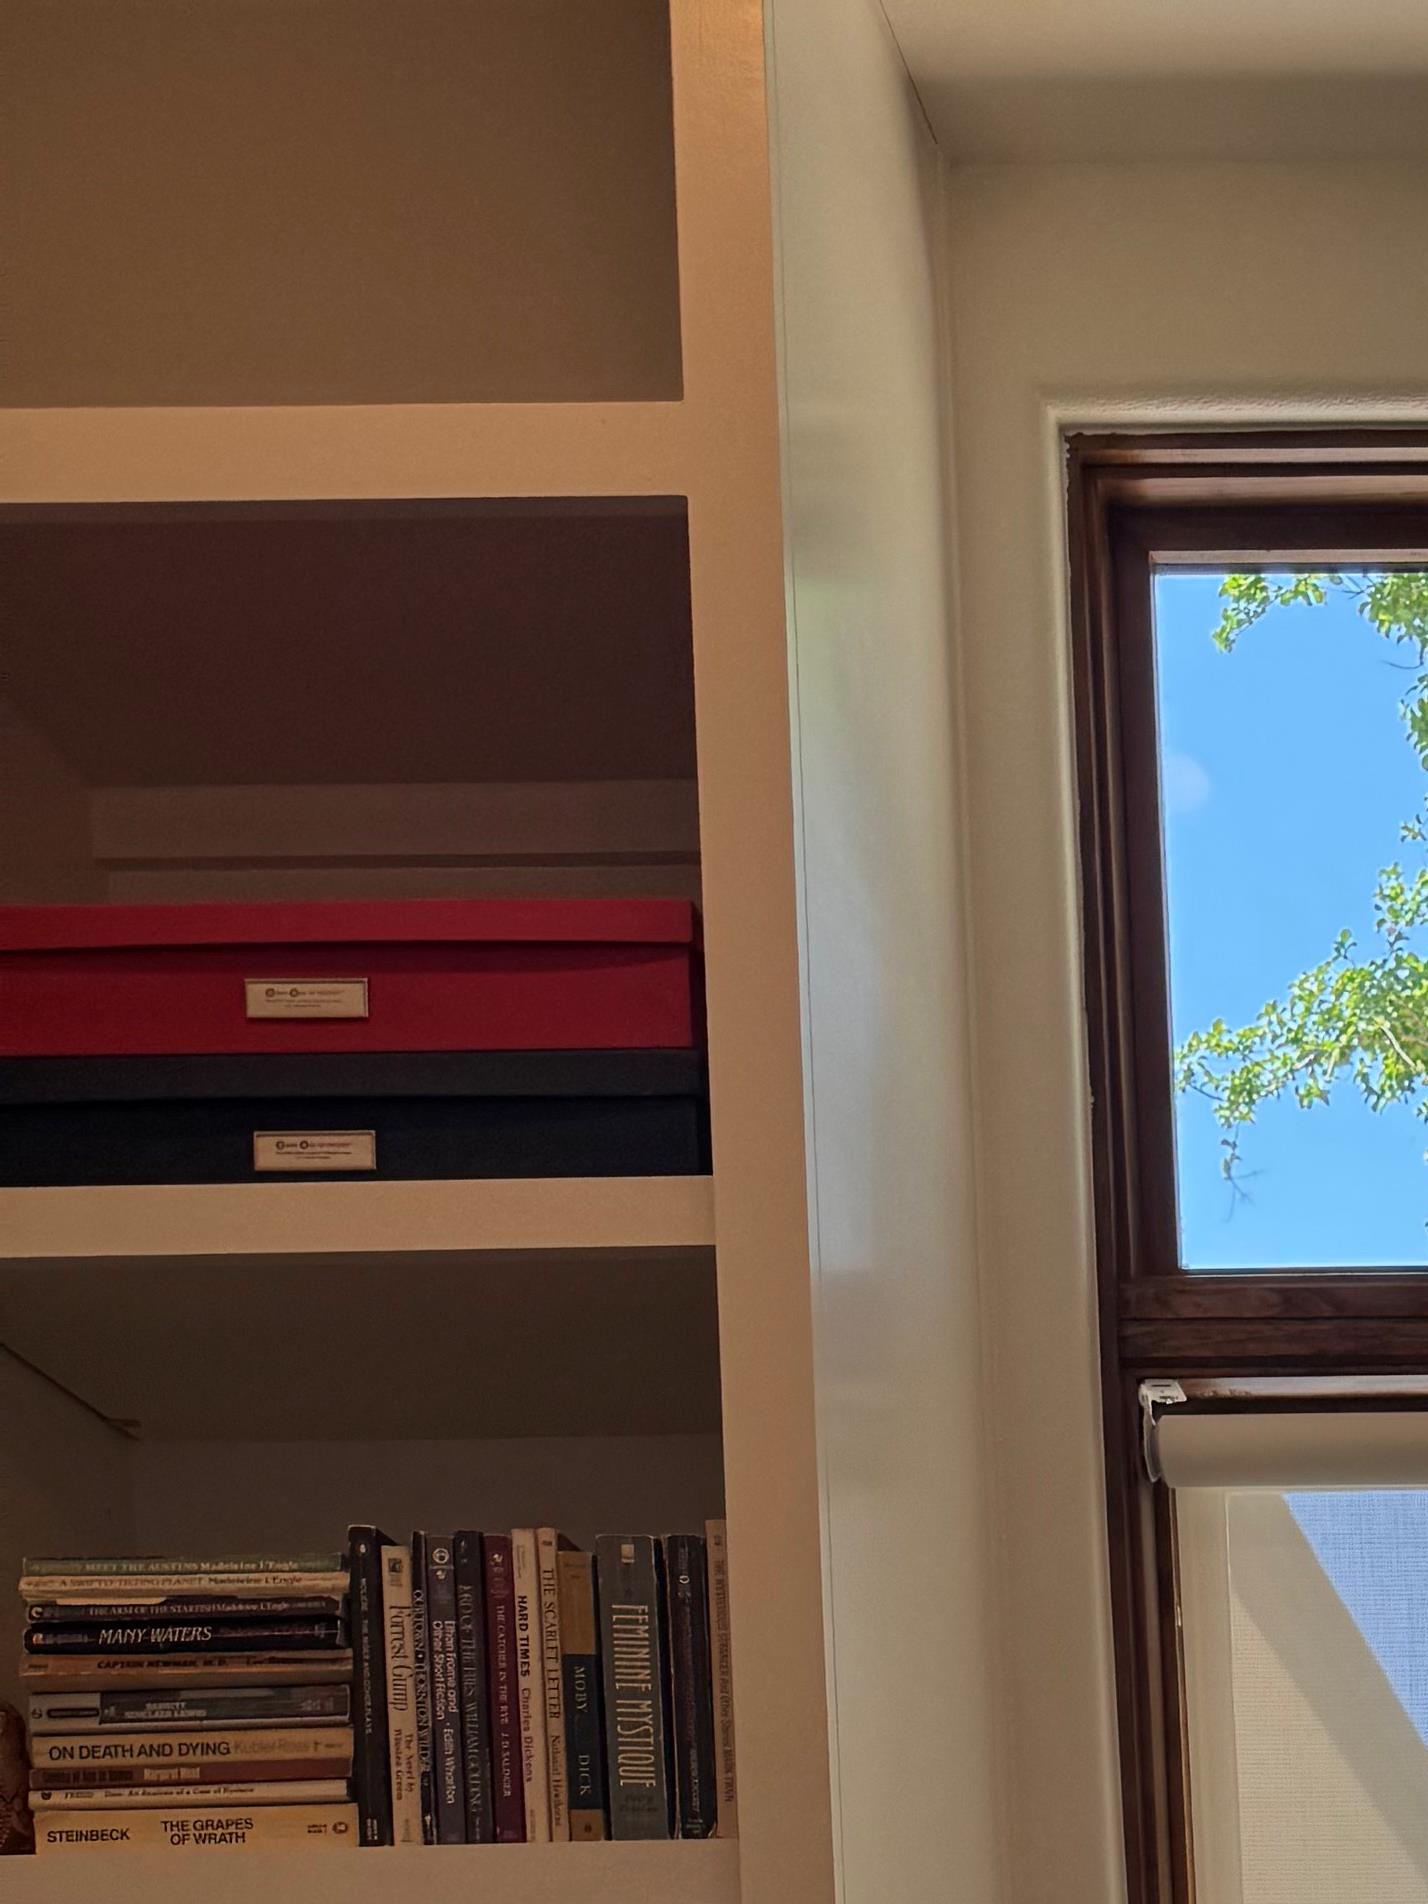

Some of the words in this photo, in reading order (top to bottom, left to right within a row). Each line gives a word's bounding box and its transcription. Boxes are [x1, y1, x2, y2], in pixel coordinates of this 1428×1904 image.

[542, 1569, 555, 1596] THE
[389, 1606, 411, 1659] Forrest
[518, 1596, 529, 1632] HARD
[544, 1602, 557, 1663] SCARLET
[99, 1630, 146, 1644] MANY
[150, 1627, 212, 1642] WATERS
[433, 1621, 444, 1650] Other
[443, 1620, 455, 1650] Ethan
[611, 1604, 652, 1692] FEMININE
[519, 1636, 530, 1677] TIMES
[391, 1666, 409, 1711] Gump
[435, 1682, 446, 1719] Fiction
[548, 1669, 559, 1719] LETTER
[574, 1665, 587, 1713] MOBY
[49, 1747, 74, 1760] ON
[79, 1745, 133, 1759] DEATH
[137, 1744, 173, 1757] AND
[178, 1742, 230, 1756] DYING
[616, 1700, 656, 1787] MYSTIQUE
[444, 1756, 456, 1804] Wharton
[578, 1754, 591, 1796] DICK
[47, 1829, 130, 1843] STEINBECK
[161, 1820, 189, 1832] THE
[193, 1818, 254, 1831] GRAPES
[170, 1833, 187, 1845] OF
[190, 1831, 245, 1844] WRATH
